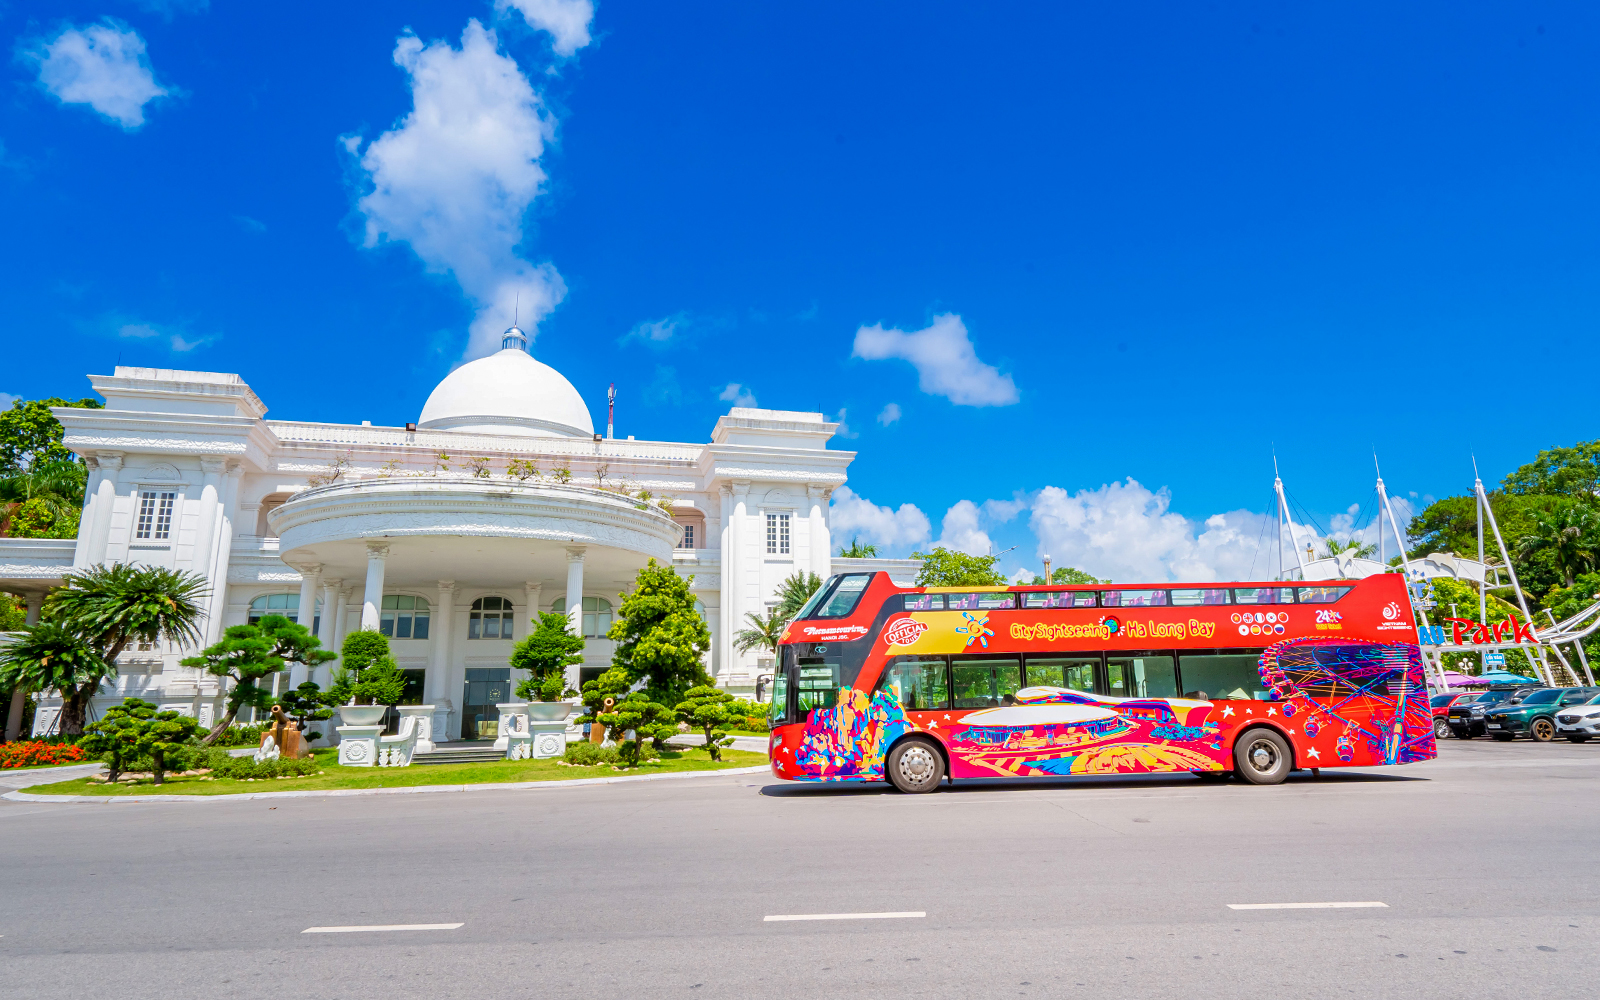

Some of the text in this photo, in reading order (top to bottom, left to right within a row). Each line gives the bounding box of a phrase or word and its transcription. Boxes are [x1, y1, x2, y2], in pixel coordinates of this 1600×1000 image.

[888, 623, 926, 642] OFFICIAL
[1127, 621, 1147, 638] Ha
[1149, 620, 1185, 639] Long
[1188, 619, 1215, 638] Bay
[1443, 614, 1539, 645] Park
[902, 634, 919, 644] TOUR
